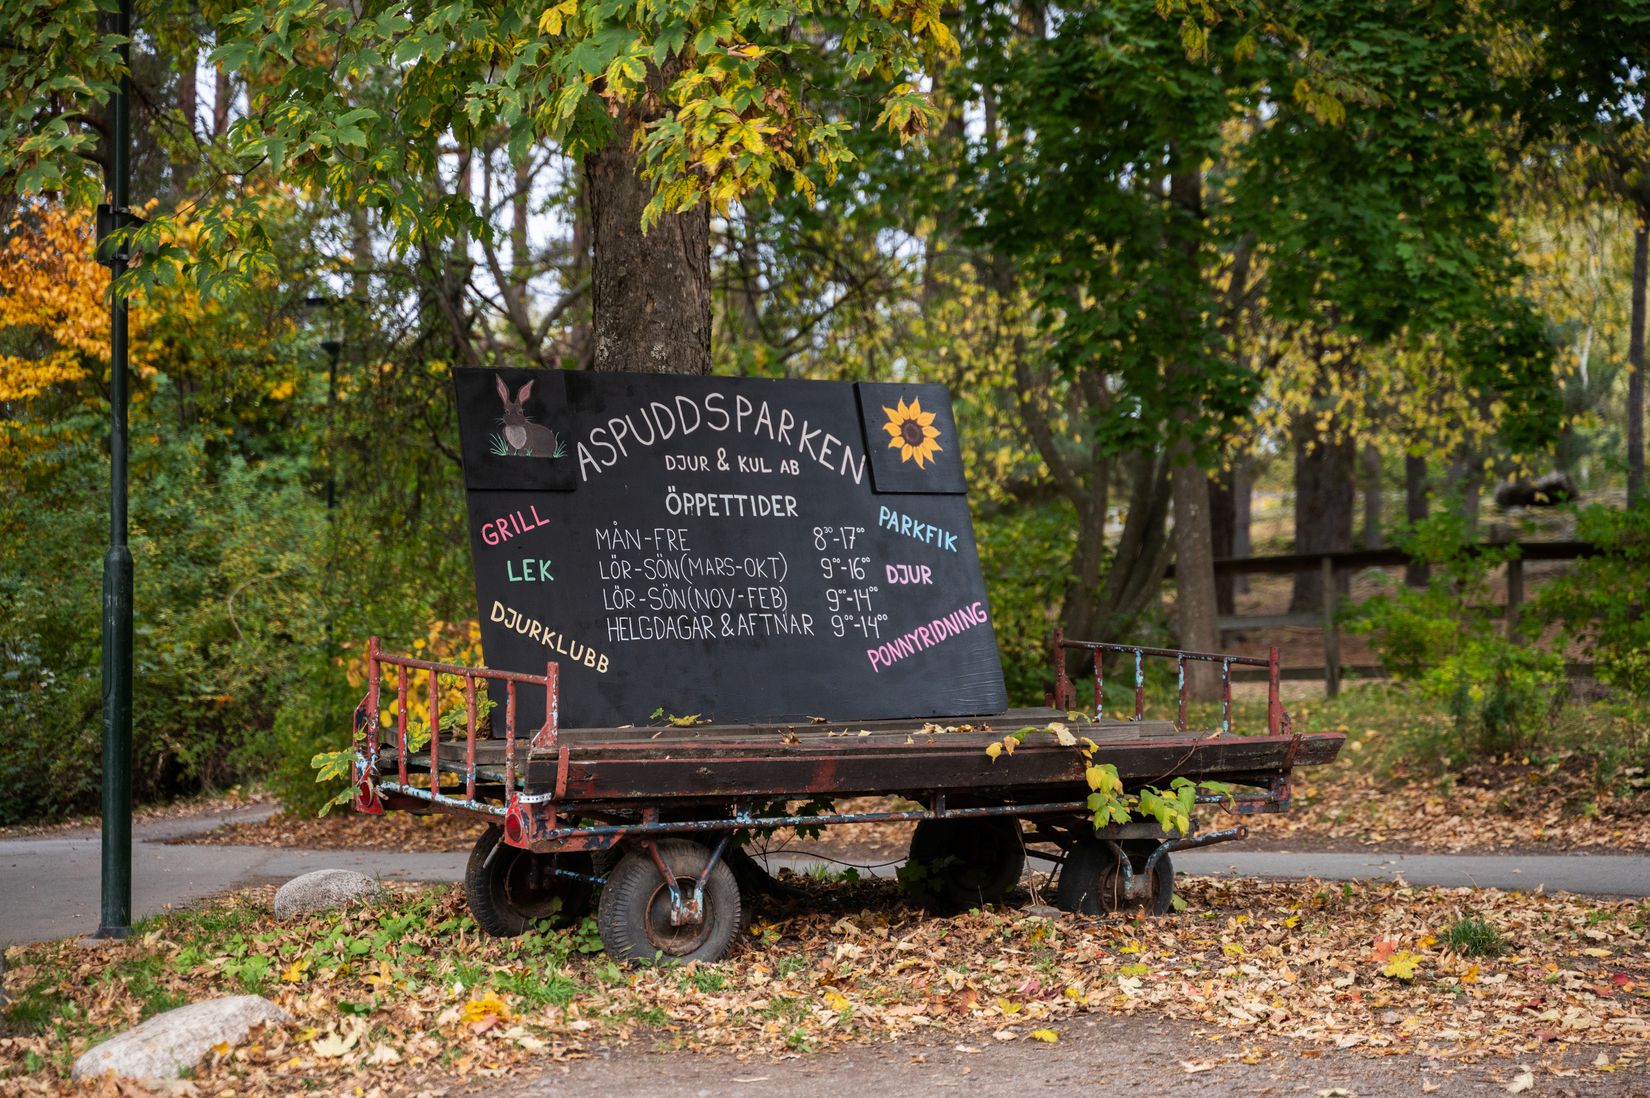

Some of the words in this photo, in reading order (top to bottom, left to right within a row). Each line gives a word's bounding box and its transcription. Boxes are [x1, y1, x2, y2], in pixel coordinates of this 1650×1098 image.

[577, 393, 866, 484] ASPUDDSPARKEN
[665, 454, 711, 472] DJUR
[717, 447, 731, 472] &
[738, 454, 772, 473] KUL
[780, 459, 800, 475] AB
[665, 486, 799, 517] ÖPPETTIDER
[481, 505, 550, 546] GRILL
[878, 505, 958, 553] PARKFIK
[507, 558, 554, 582] LEK
[885, 564, 933, 585] DJUR
[490, 600, 609, 674] DJURKLUBB
[606, 615, 716, 642] HELGDAGAR
[738, 613, 815, 637] AFTNAR
[866, 602, 988, 673] PONNYRIDNING
